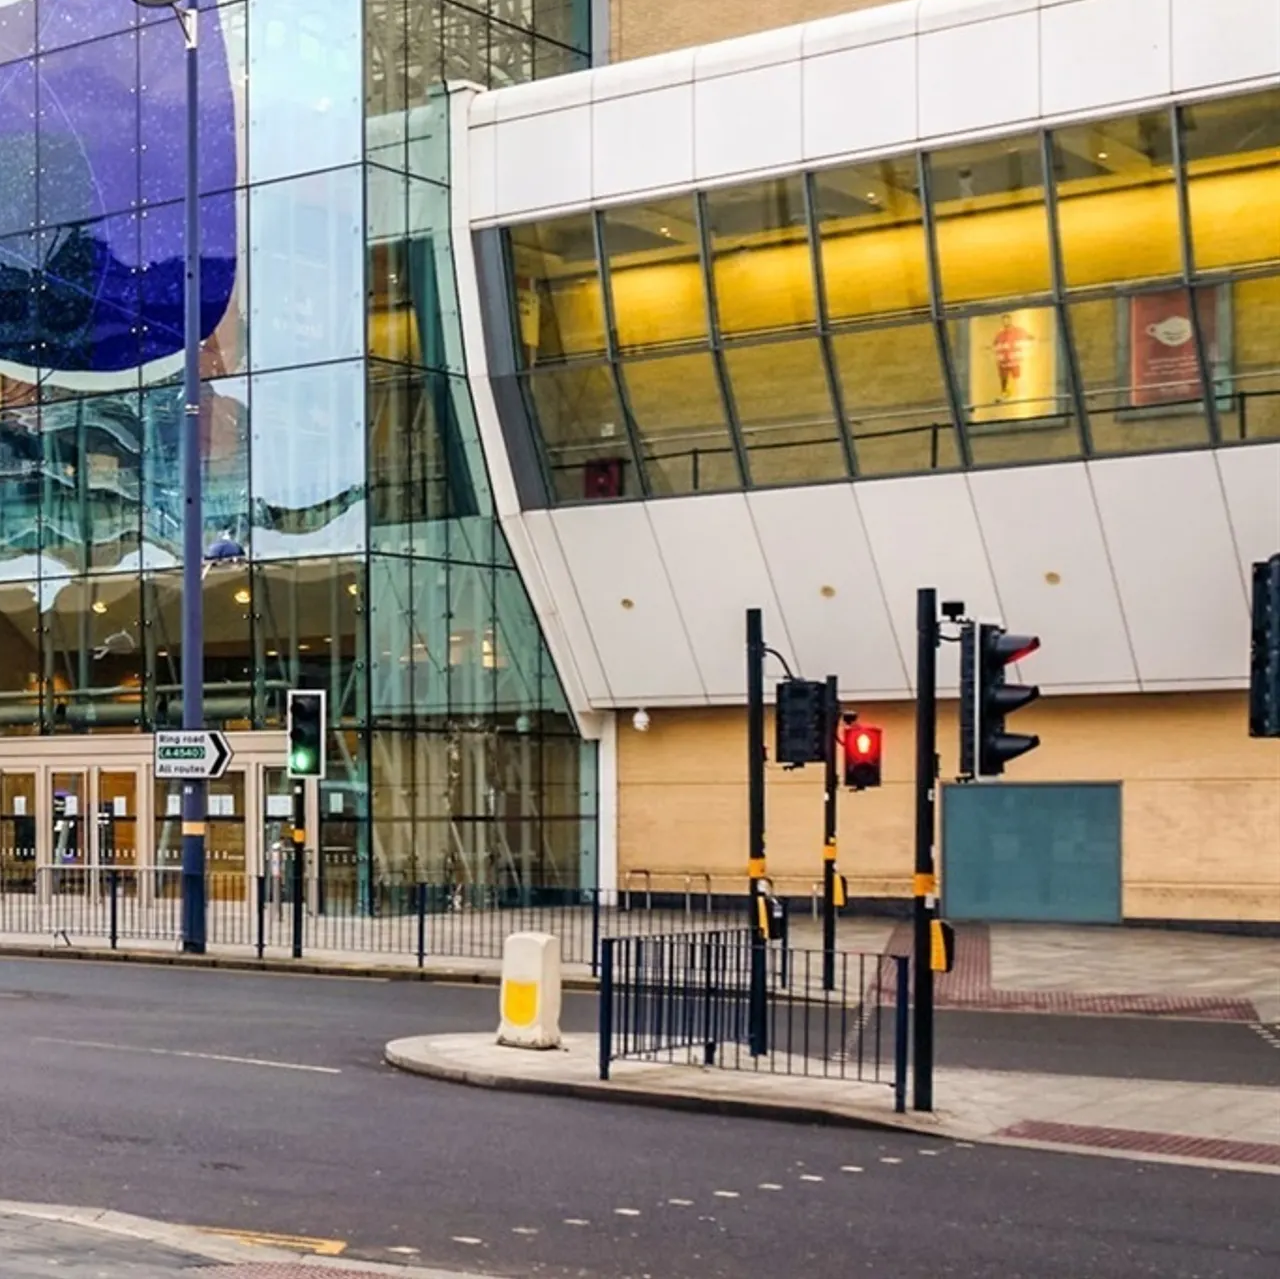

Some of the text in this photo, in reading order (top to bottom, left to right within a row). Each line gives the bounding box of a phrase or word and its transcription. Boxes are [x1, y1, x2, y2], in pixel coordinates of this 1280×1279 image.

[159, 734, 205, 744] Ring road
[159, 764, 205, 773] All routes
